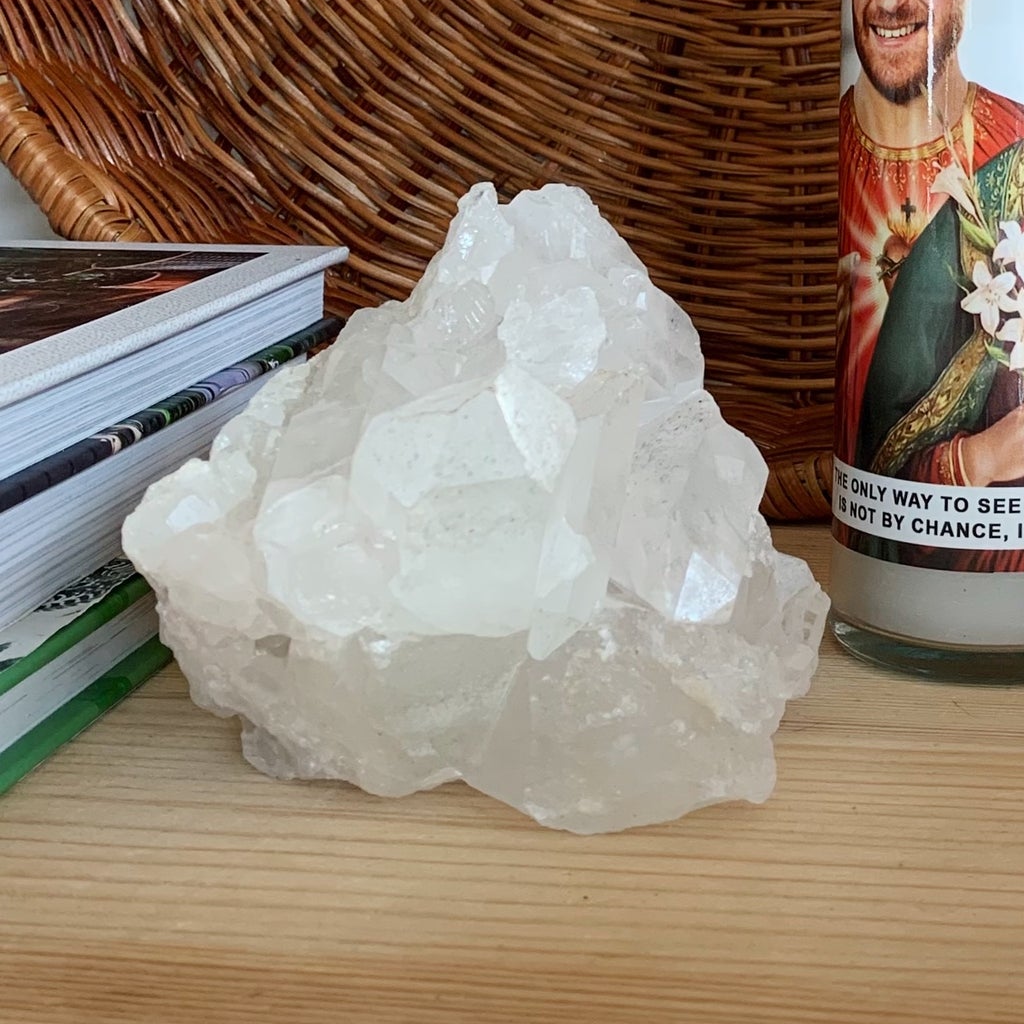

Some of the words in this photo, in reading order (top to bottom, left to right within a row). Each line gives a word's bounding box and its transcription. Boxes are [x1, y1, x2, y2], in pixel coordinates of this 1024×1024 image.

[834, 466, 848, 490] THE
[851, 478, 887, 502] ONLY
[892, 488, 933, 510] WAY
[940, 495, 969, 513] TO
[977, 498, 1021, 514] SEE
[838, 495, 847, 513] IS
[850, 501, 876, 524] NOT
[882, 511, 905, 531] BY
[911, 517, 1008, 542] CHANCE,
